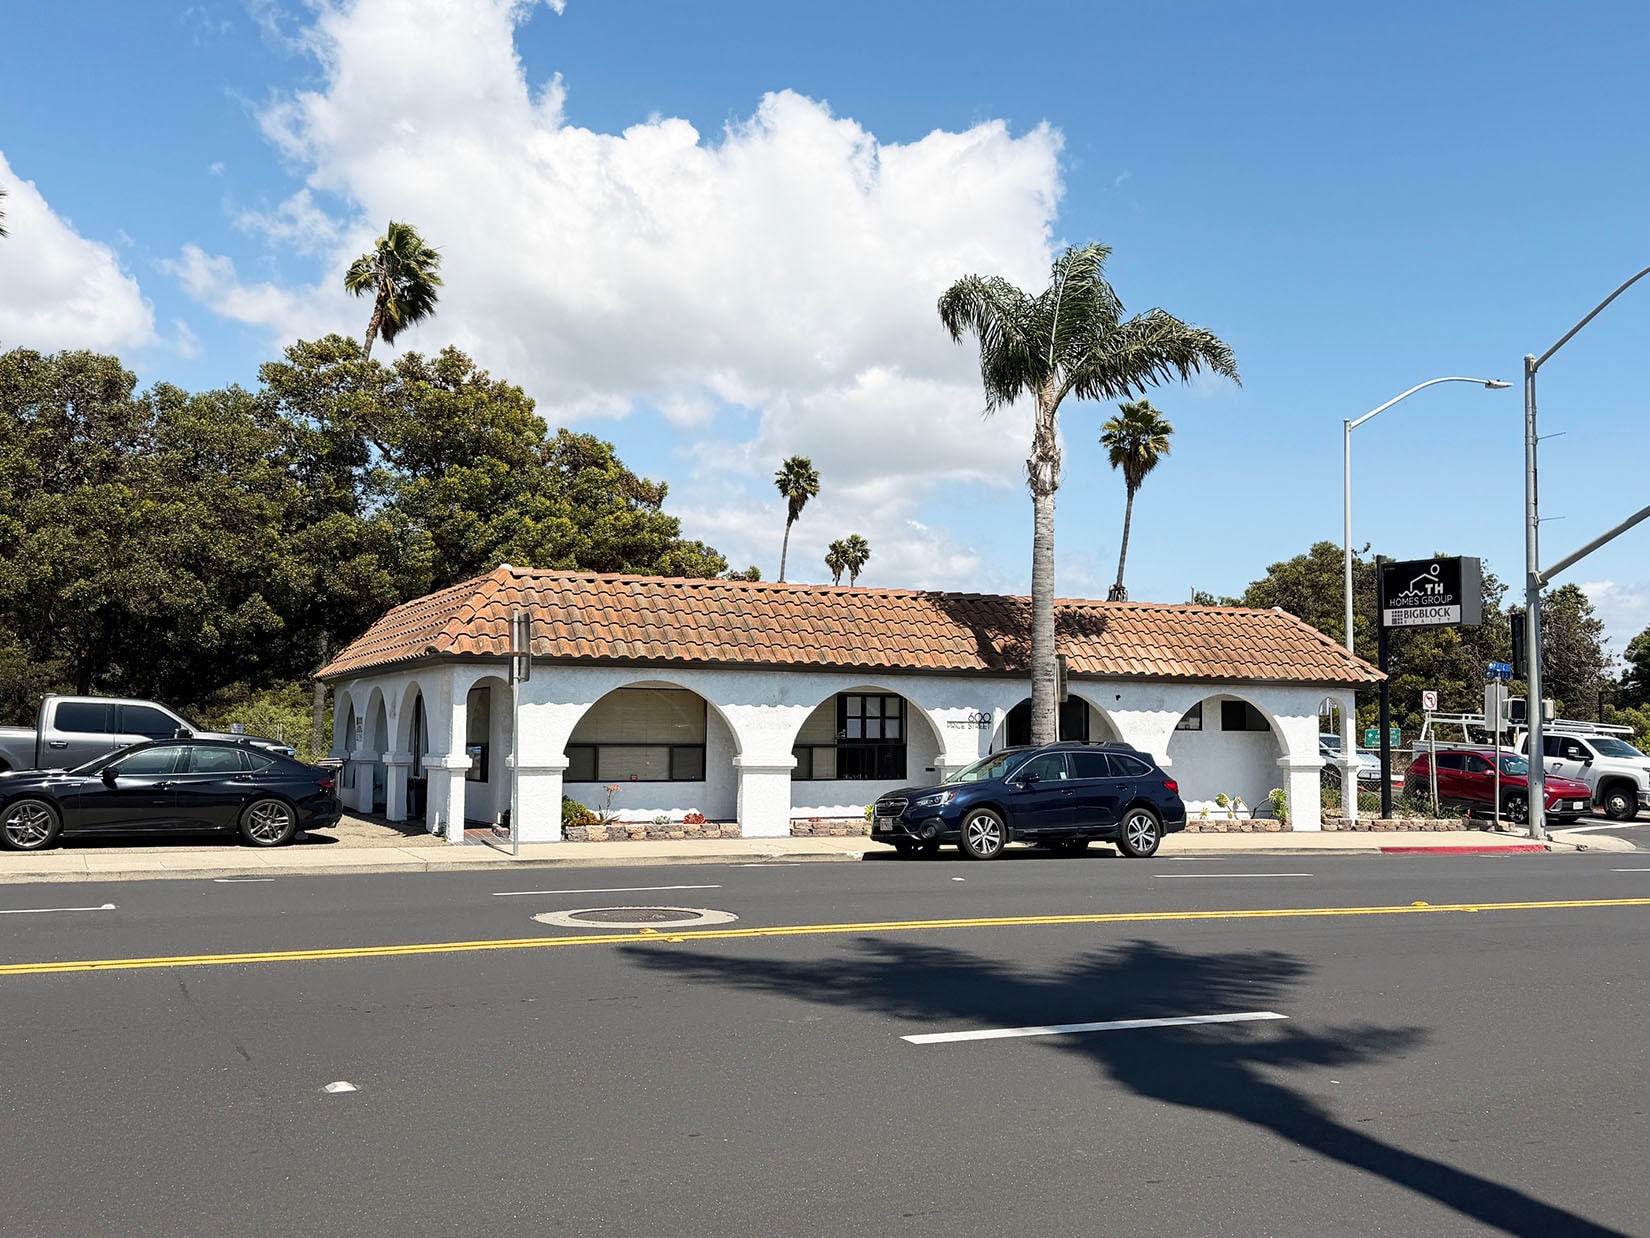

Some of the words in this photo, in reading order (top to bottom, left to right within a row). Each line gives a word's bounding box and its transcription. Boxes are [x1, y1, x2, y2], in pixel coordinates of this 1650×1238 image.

[1425, 583, 1444, 595] TH
[1390, 597, 1420, 606] HOMES
[1422, 595, 1452, 604] GROUP
[1404, 607, 1450, 618] BIGBLOCK
[968, 712, 991, 723] 600
